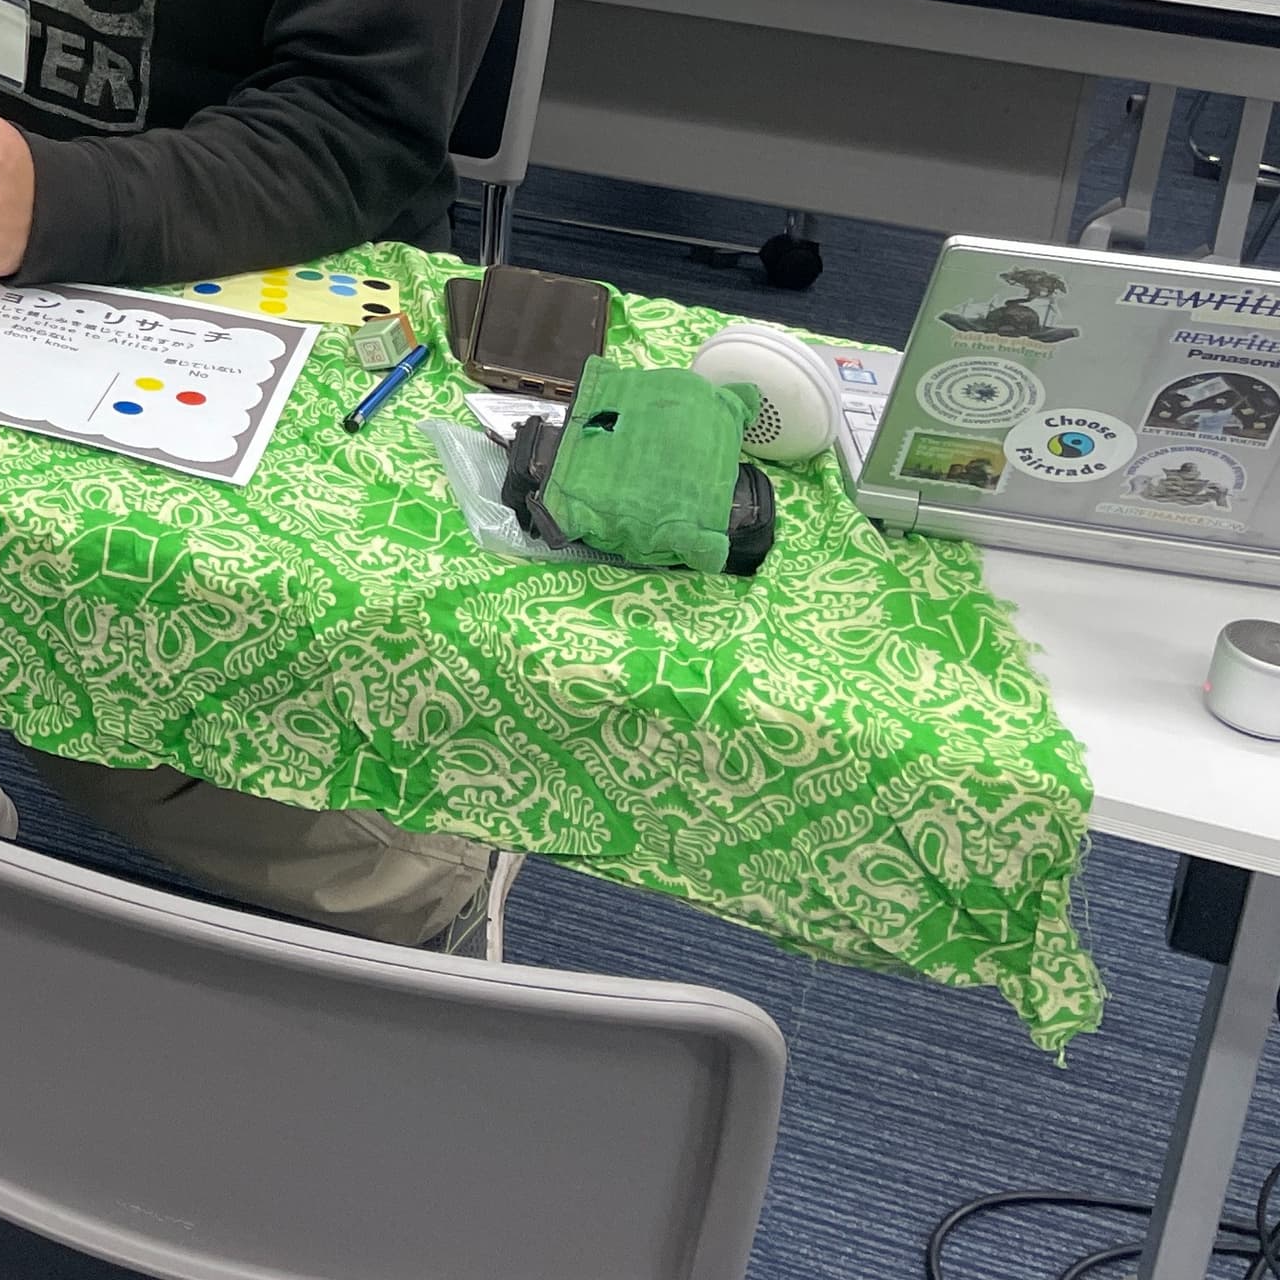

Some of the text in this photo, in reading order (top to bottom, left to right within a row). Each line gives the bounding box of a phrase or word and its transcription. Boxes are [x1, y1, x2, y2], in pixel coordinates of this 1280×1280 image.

[4, 330, 38, 342] don't
[45, 338, 80, 352] know
[12, 323, 73, 342] わからない
[34, 320, 77, 333] close
[85, 331, 101, 340] to
[108, 337, 170, 353] Africa?
[189, 369, 209, 379] No
[1044, 415, 1117, 440] Choose
[1016, 447, 1107, 477] Fairtrade
